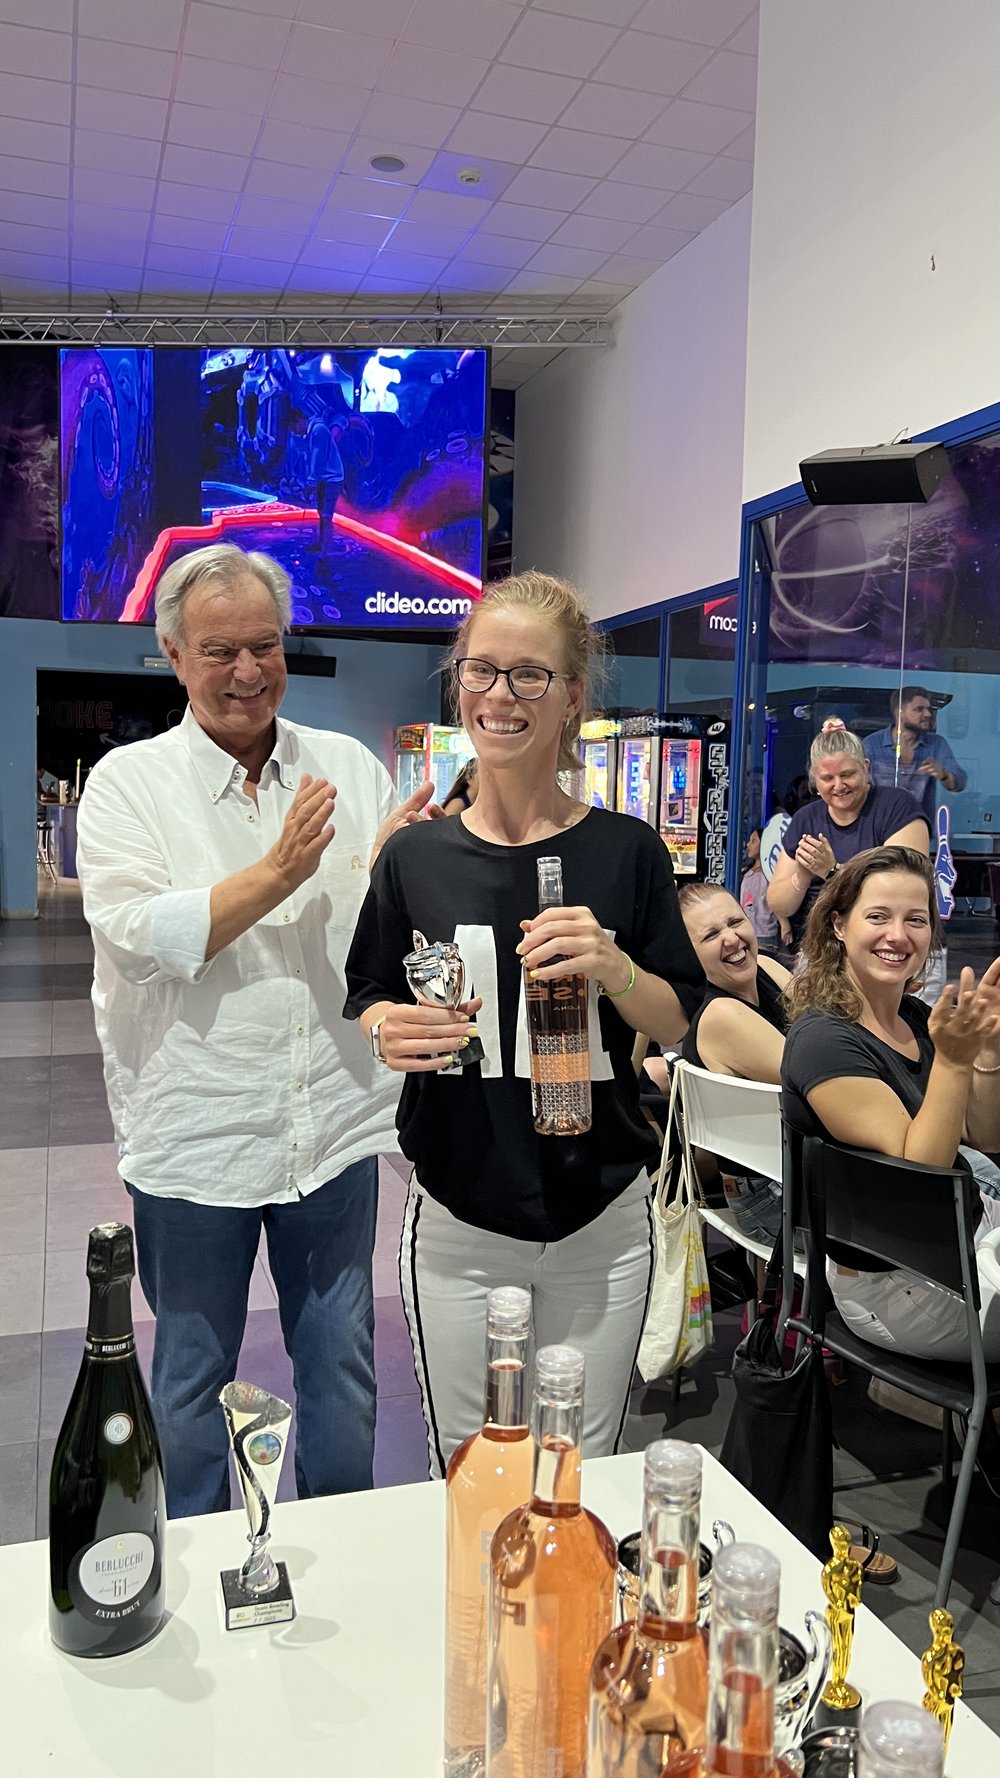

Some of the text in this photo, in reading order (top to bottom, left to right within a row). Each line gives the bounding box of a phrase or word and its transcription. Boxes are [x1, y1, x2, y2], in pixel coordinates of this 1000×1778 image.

[364, 591, 472, 615] clideo.com
[95, 1550, 144, 1573] BERLUCCHI
[95, 1608, 121, 1618] EXTRA
